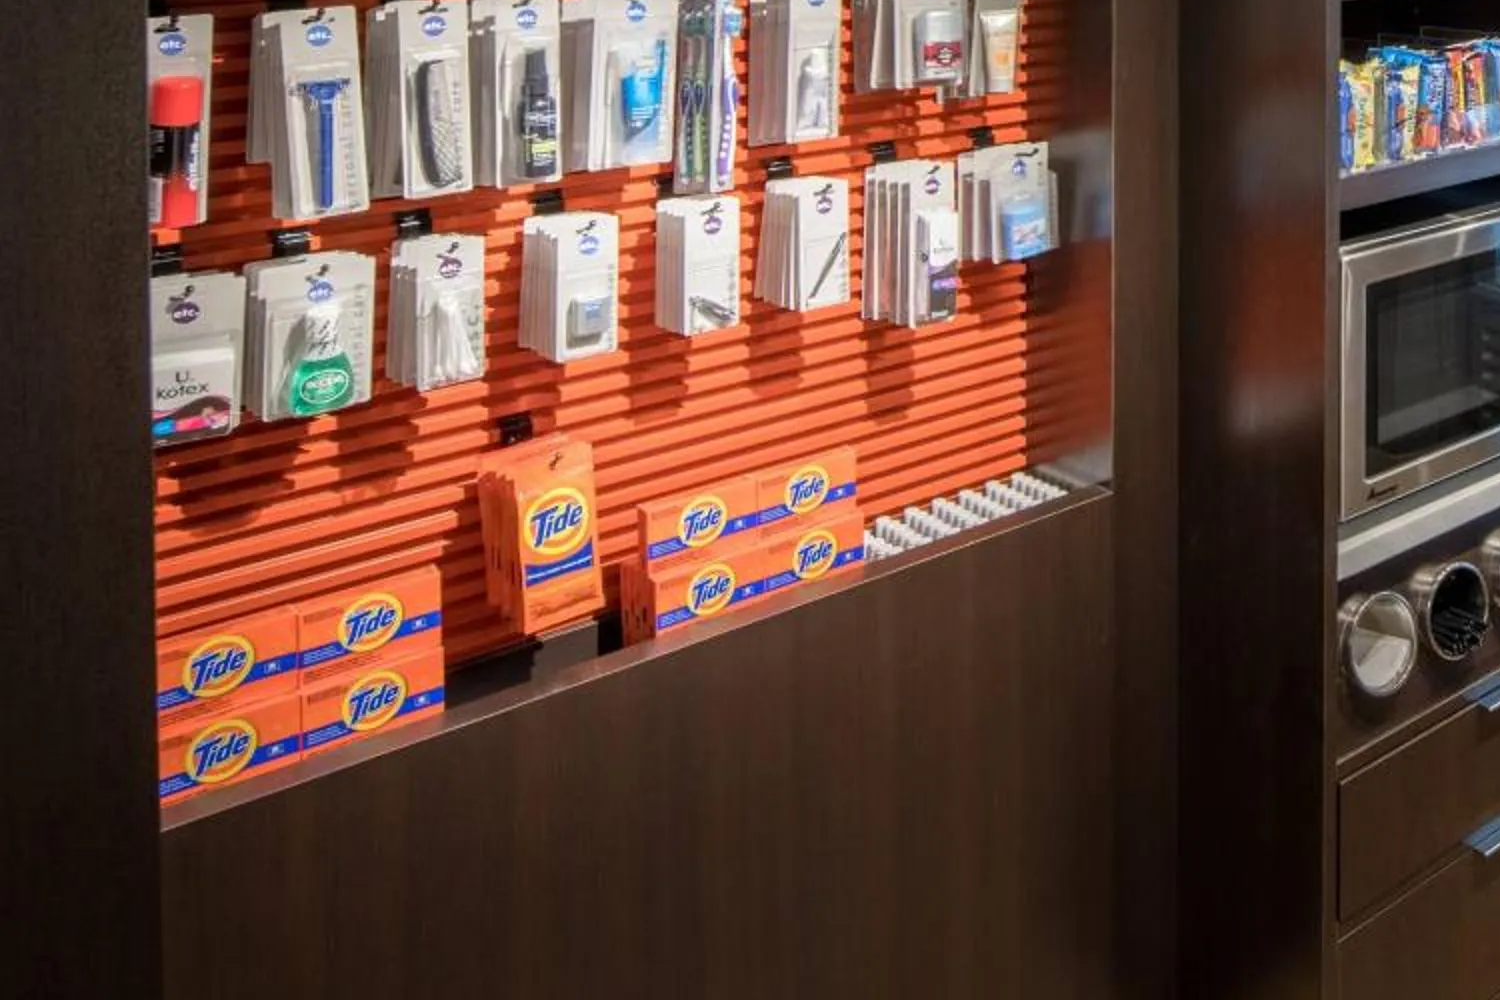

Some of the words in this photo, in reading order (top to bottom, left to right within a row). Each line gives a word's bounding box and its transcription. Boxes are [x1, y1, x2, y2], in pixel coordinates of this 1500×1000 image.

[789, 475, 826, 507] Tide
[530, 503, 584, 547] Tide
[682, 506, 722, 542] Tide
[798, 540, 834, 571] Tide
[691, 572, 732, 605] Tide
[346, 606, 396, 646] Tide
[190, 649, 246, 691] Tide
[351, 682, 399, 726] Tide
[193, 733, 250, 777] Tide
